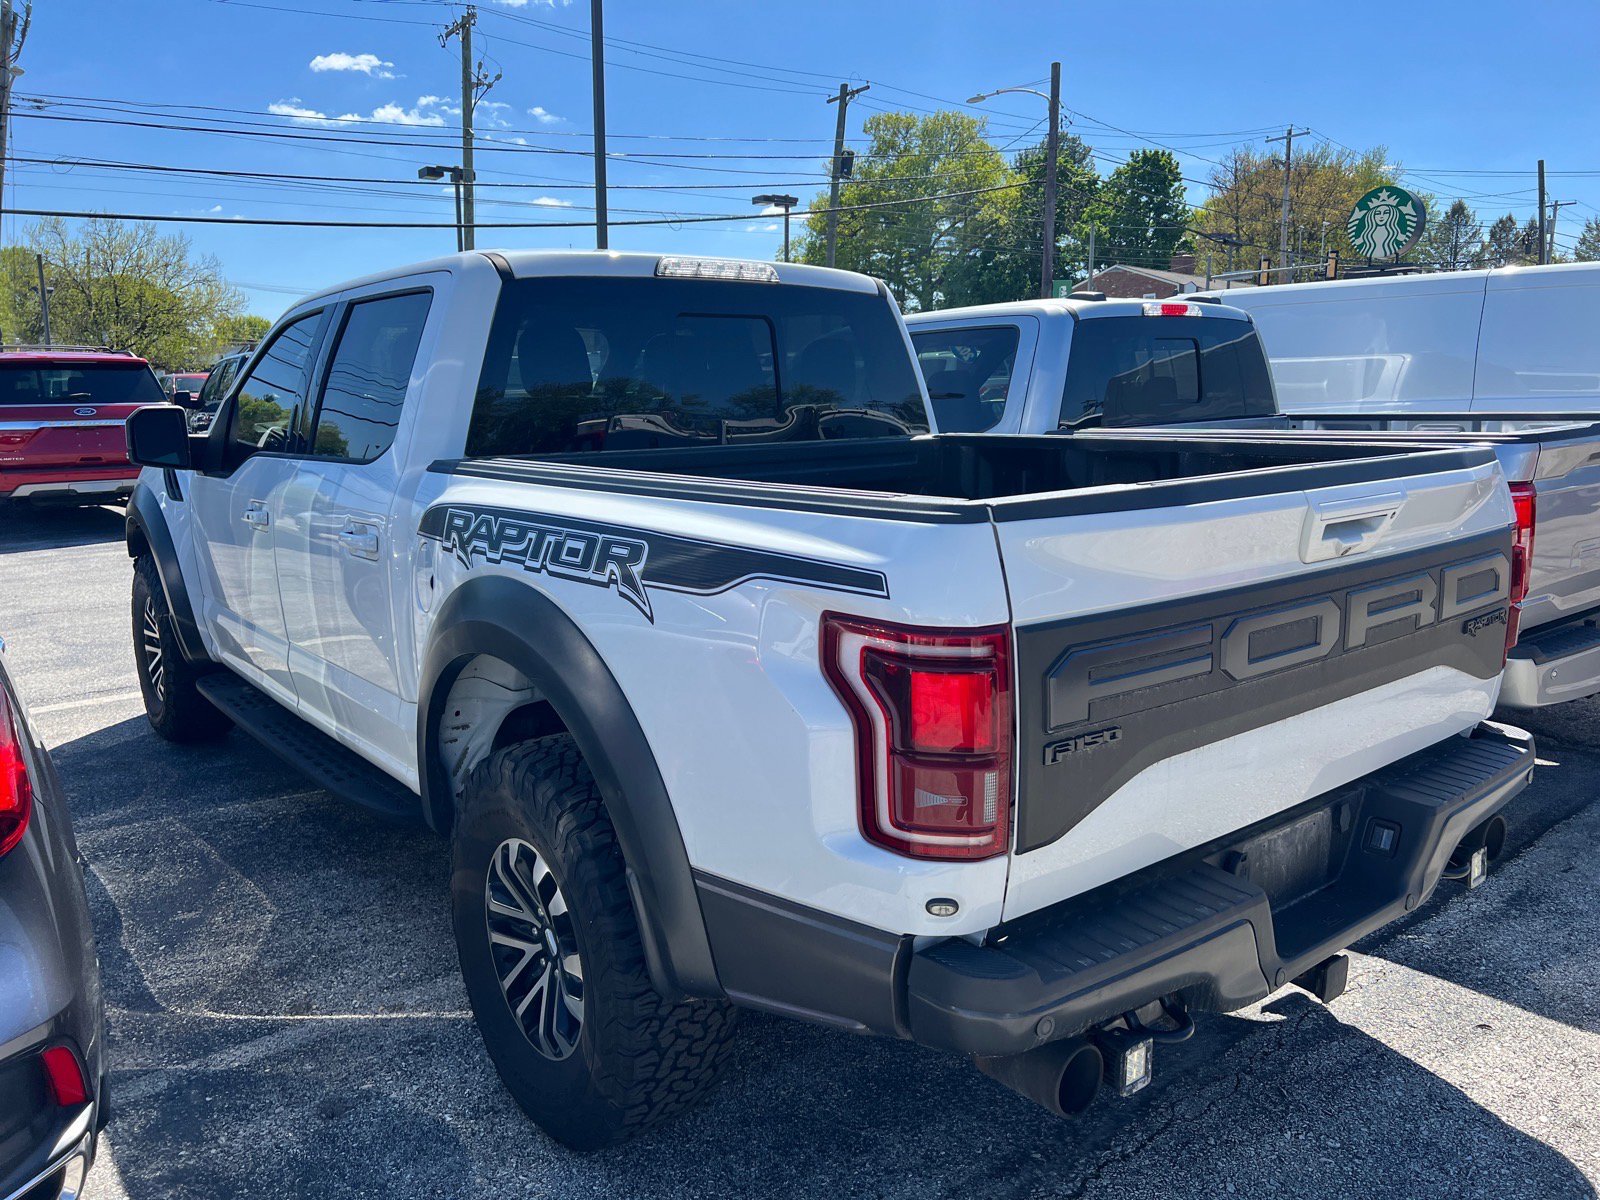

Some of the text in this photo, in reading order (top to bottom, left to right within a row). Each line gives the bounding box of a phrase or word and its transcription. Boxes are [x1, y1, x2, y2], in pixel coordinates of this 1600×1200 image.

[442, 508, 654, 625] RAPTOR
[1045, 552, 1510, 734] FORD
[1462, 607, 1507, 637] RAPTOR
[1043, 725, 1122, 766] F150
